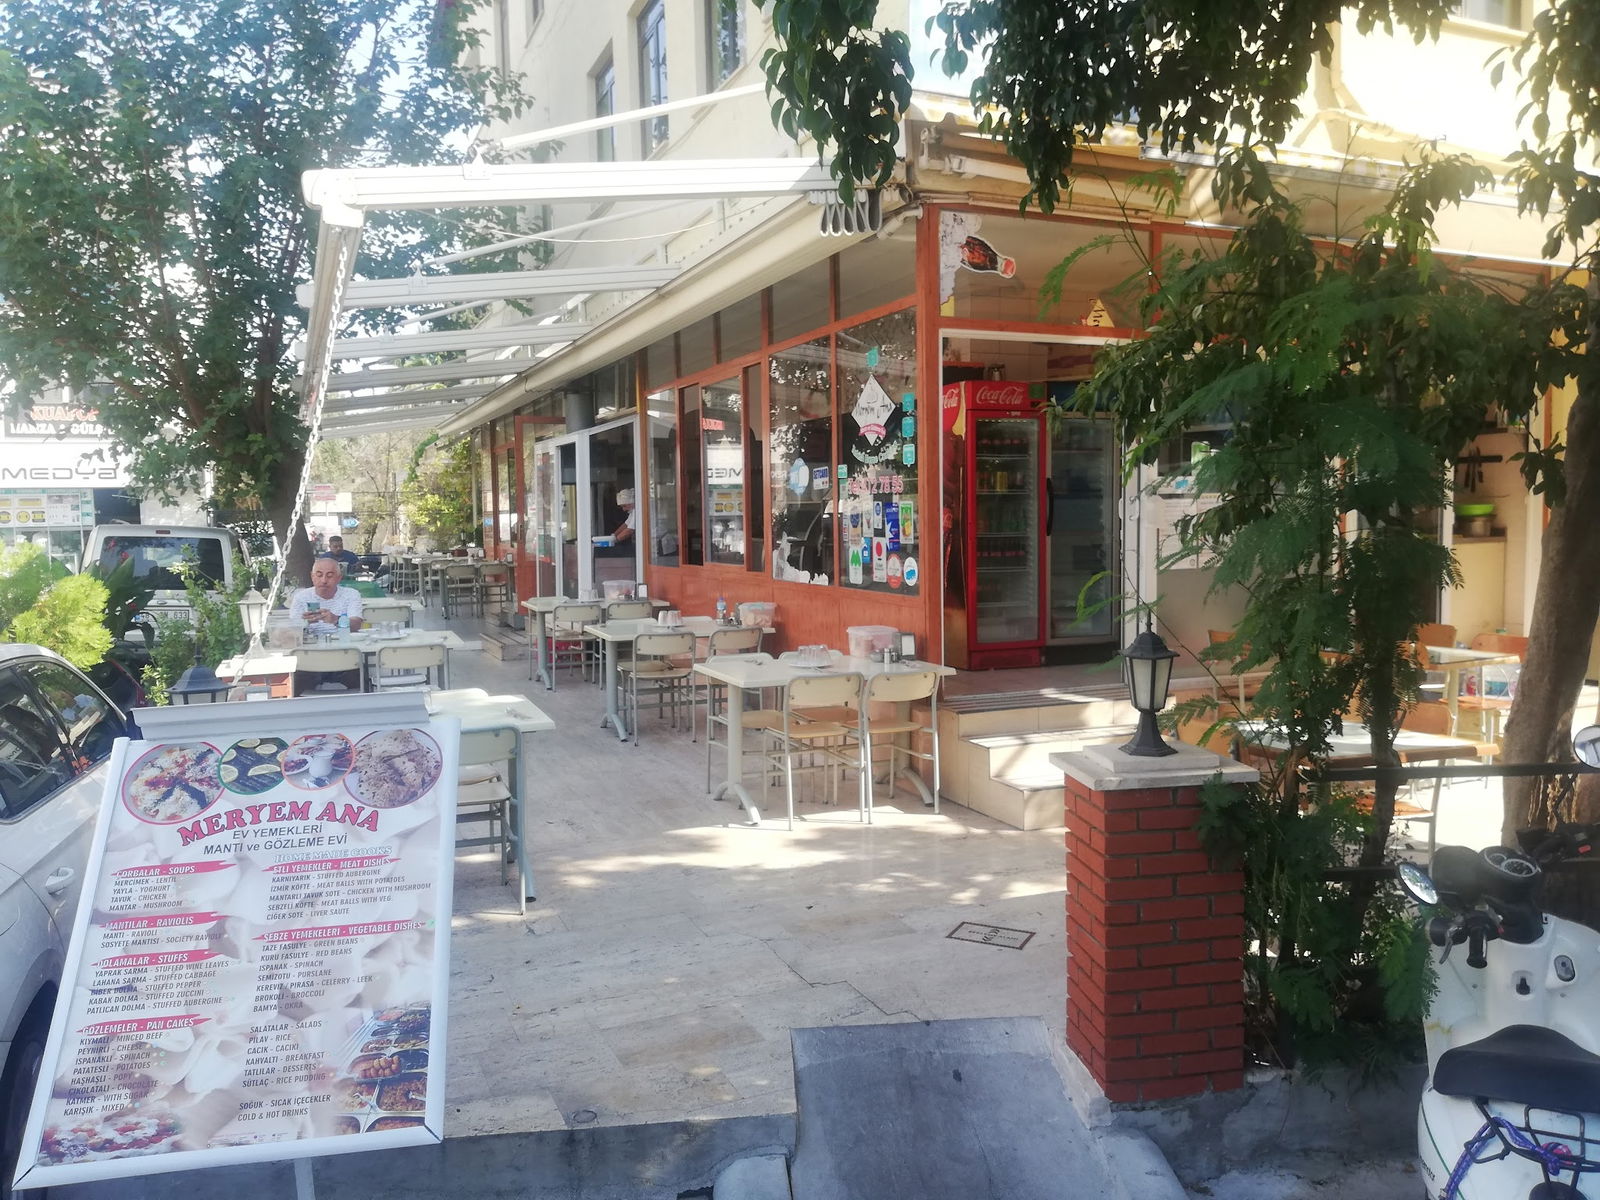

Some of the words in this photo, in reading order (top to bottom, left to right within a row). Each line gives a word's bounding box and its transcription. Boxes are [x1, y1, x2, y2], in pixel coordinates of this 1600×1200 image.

[177, 801, 312, 846] MERYEM
[316, 801, 379, 832] ANA
[233, 829, 247, 840] EV
[251, 822, 322, 839] YEMEKLERİ
[203, 842, 243, 855] MANTI
[247, 842, 260, 851] ve
[264, 836, 324, 850] GÖZLEME
[328, 833, 348, 845] EVİ
[291, 863, 331, 872] YEMEKLER
[347, 887, 374, 896] CHICKEN
[394, 883, 431, 892] MUSHROOM
[321, 898, 339, 906] MEAT
[264, 932, 288, 941] SEBZE
[349, 924, 391, 935] VEGETABLE
[394, 921, 422, 930] DISHES
[158, 953, 188, 963] STUFFS
[261, 953, 278, 962] KURU
[95, 969, 122, 977] YAPRAK
[185, 971, 216, 979] CABBAGE
[298, 969, 331, 978] PURSLANE
[114, 984, 138, 993] DOLMA
[89, 997, 112, 1005] KABAK
[114, 995, 138, 1003] DOLMA
[146, 992, 174, 1000] STUFFED
[121, 1003, 145, 1011] DOLMA
[153, 1000, 181, 1009] STUFFED
[184, 997, 222, 1006] AUBERGINE
[147, 1021, 164, 1029] PAN
[166, 1018, 194, 1028] CAKES
[250, 1024, 288, 1033] SALATALAR
[295, 1021, 322, 1029] SALADS
[80, 1037, 109, 1045] KIYMALI
[120, 1053, 150, 1061] SPINACH
[246, 1056, 278, 1066] KAHVALTI
[286, 1052, 324, 1062] BREAKFAST
[116, 1062, 150, 1070] POTATOES
[244, 1065, 275, 1076] TATLILAR
[283, 1063, 317, 1073] DESSERTS
[295, 1074, 326, 1082] PUDDING
[66, 1096, 95, 1105] KATMER
[104, 1092, 122, 1101] WITH
[124, 1091, 148, 1099] SUGAR
[271, 1098, 291, 1107] SICAK
[101, 1104, 124, 1112] MIXED
[266, 1110, 279, 1118] HOT
[282, 1108, 308, 1117] DRINKS
